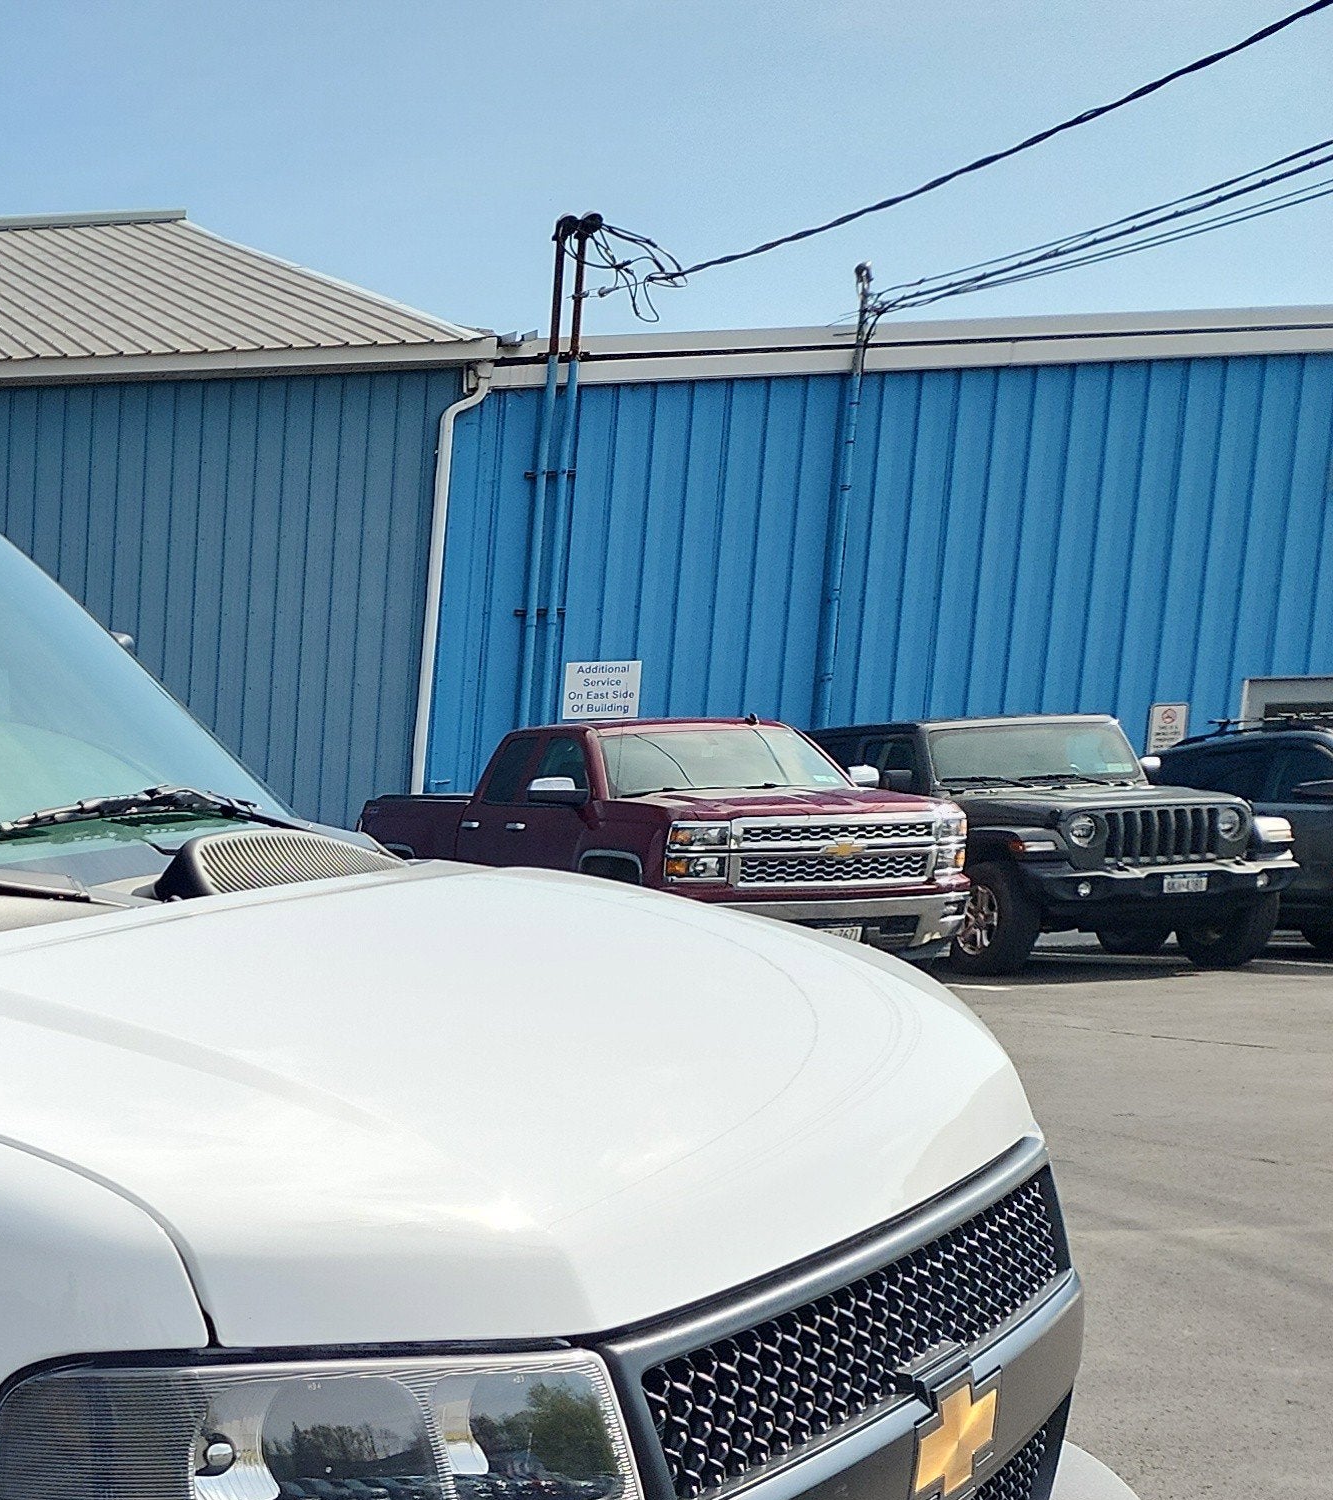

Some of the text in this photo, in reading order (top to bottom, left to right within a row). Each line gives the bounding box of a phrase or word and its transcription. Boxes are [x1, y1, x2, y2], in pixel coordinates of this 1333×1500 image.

[577, 664, 630, 674] Additional
[583, 679, 622, 687] Service
[568, 690, 635, 700] On East Side
[571, 703, 629, 714] Of Building
